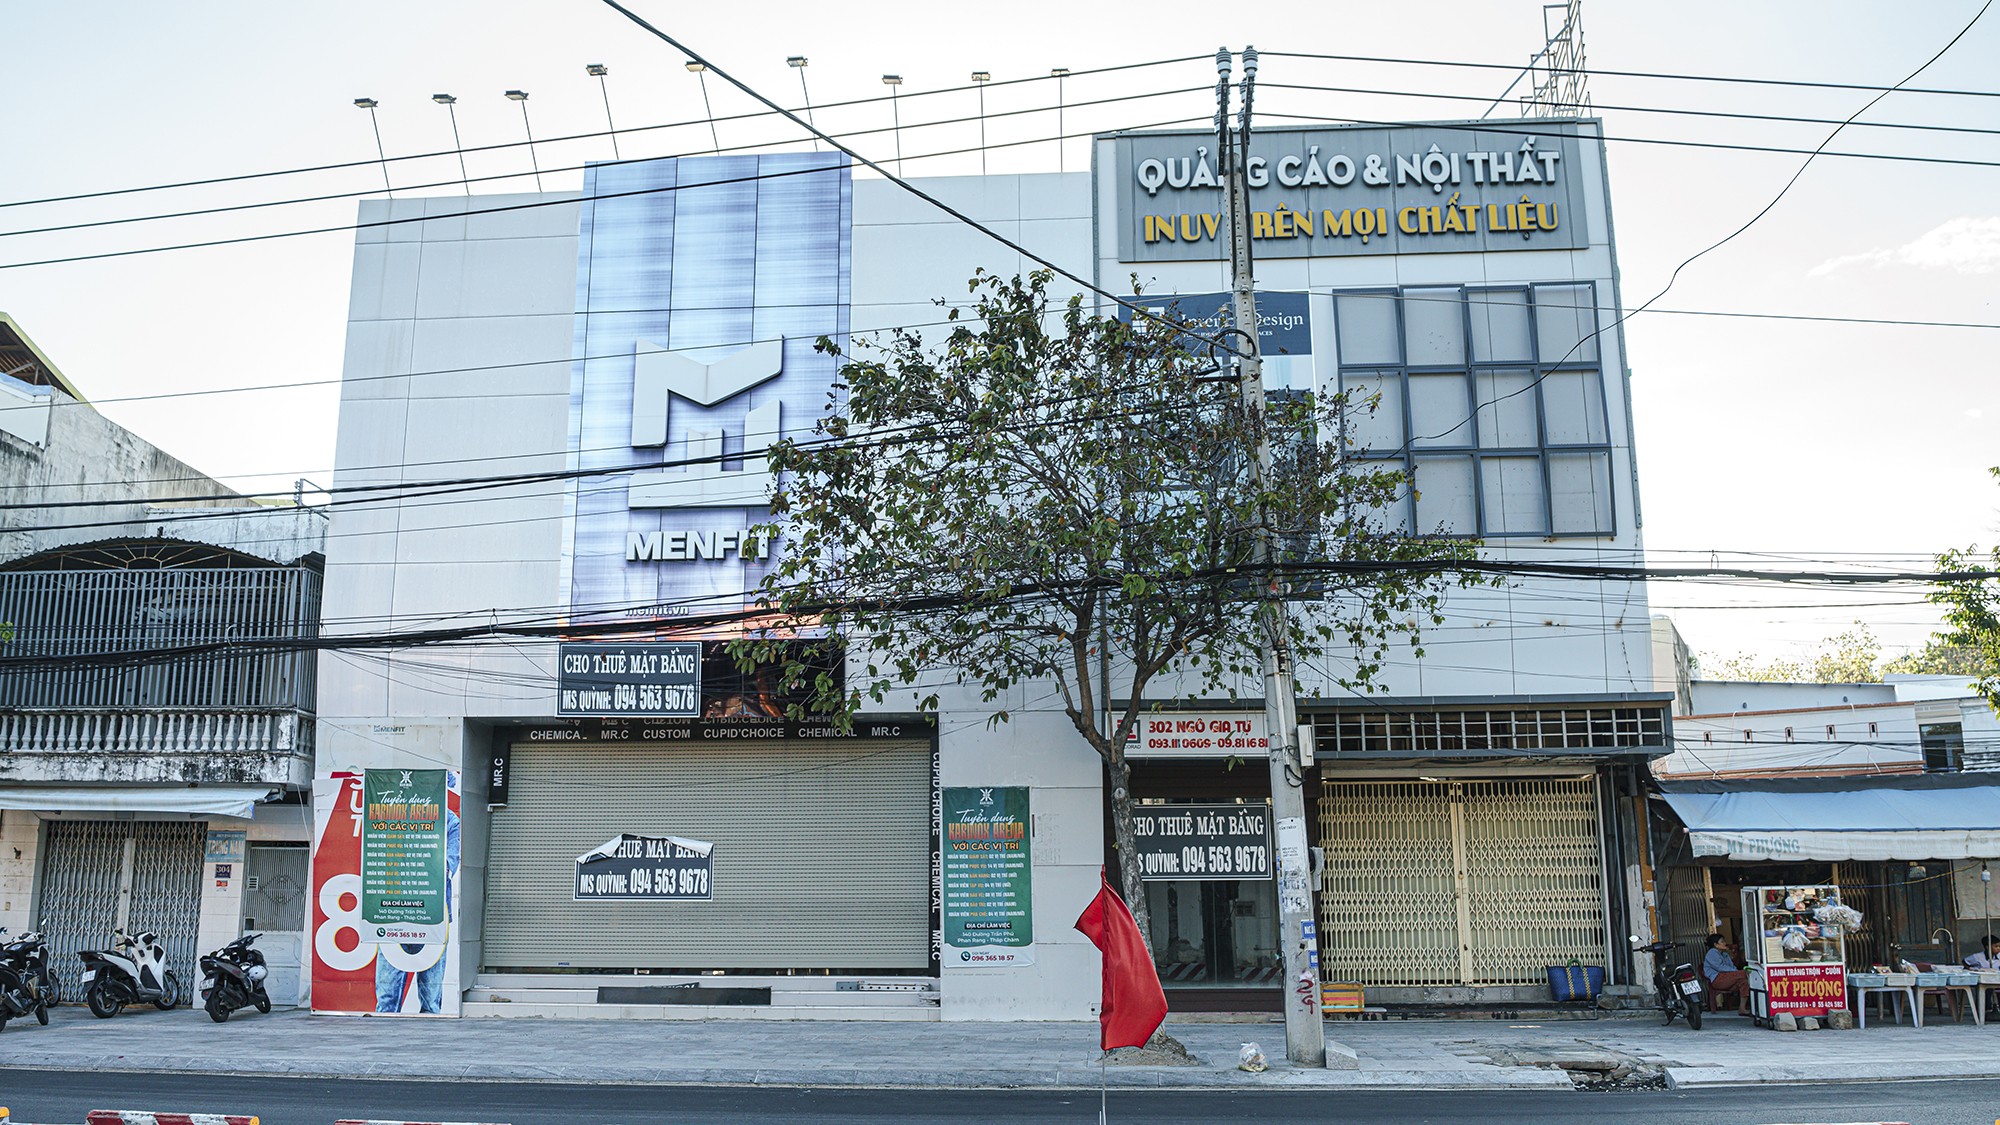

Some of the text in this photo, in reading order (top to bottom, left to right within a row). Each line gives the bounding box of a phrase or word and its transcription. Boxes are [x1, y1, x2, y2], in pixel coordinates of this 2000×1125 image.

[1137, 135, 1560, 195] QUẢG CÁO & NỘI THẤT
[1144, 192, 1559, 244] IN UV RÊN MỌI CHẤT LIỆU
[626, 530, 776, 562] MENFIT
[564, 647, 695, 679] CHO THUÊ MẶT BẰNG
[562, 684, 695, 711] MS QUỲNH: 094 563 9678
[601, 730, 629, 740] MR.C
[642, 729, 691, 740] CUSTOM
[798, 727, 857, 738] CHEMICAL
[871, 726, 900, 737] MR.C
[1149, 718, 1252, 736] 302 NGÔ GIA TỰ
[493, 757, 504, 787] MR.C
[377, 790, 432, 807] Tuyển dụng
[369, 803, 439, 820] KARINOX ARENA
[956, 808, 1016, 826] Tuyển dụng
[372, 821, 435, 833] VỚI CÁC VỊ TRÍ
[948, 822, 1024, 840] KARINOX ARENA
[1158, 811, 1193, 836] THUÊ
[1197, 811, 1225, 840] MẶT
[1229, 808, 1264, 836] BẰNG
[952, 840, 1020, 852] VỚI CÁC VỊ TRÍ
[1749, 837, 1801, 857] PHƯỢNG
[1146, 849, 1179, 875] QUỲNH:
[1182, 846, 1206, 873] 094
[1209, 846, 1232, 873] 563
[1235, 846, 1266, 873] 9678
[580, 868, 708, 896] MS QUỲNH: 094 563 9678
[1770, 968, 1786, 977] BÁNH
[1787, 967, 1805, 976] TRÁNG
[1806, 966, 1821, 976] TRỘN
[1825, 965, 1841, 975] CUỐN
[1771, 977, 1842, 1000] MỸ PHƯỢNG
